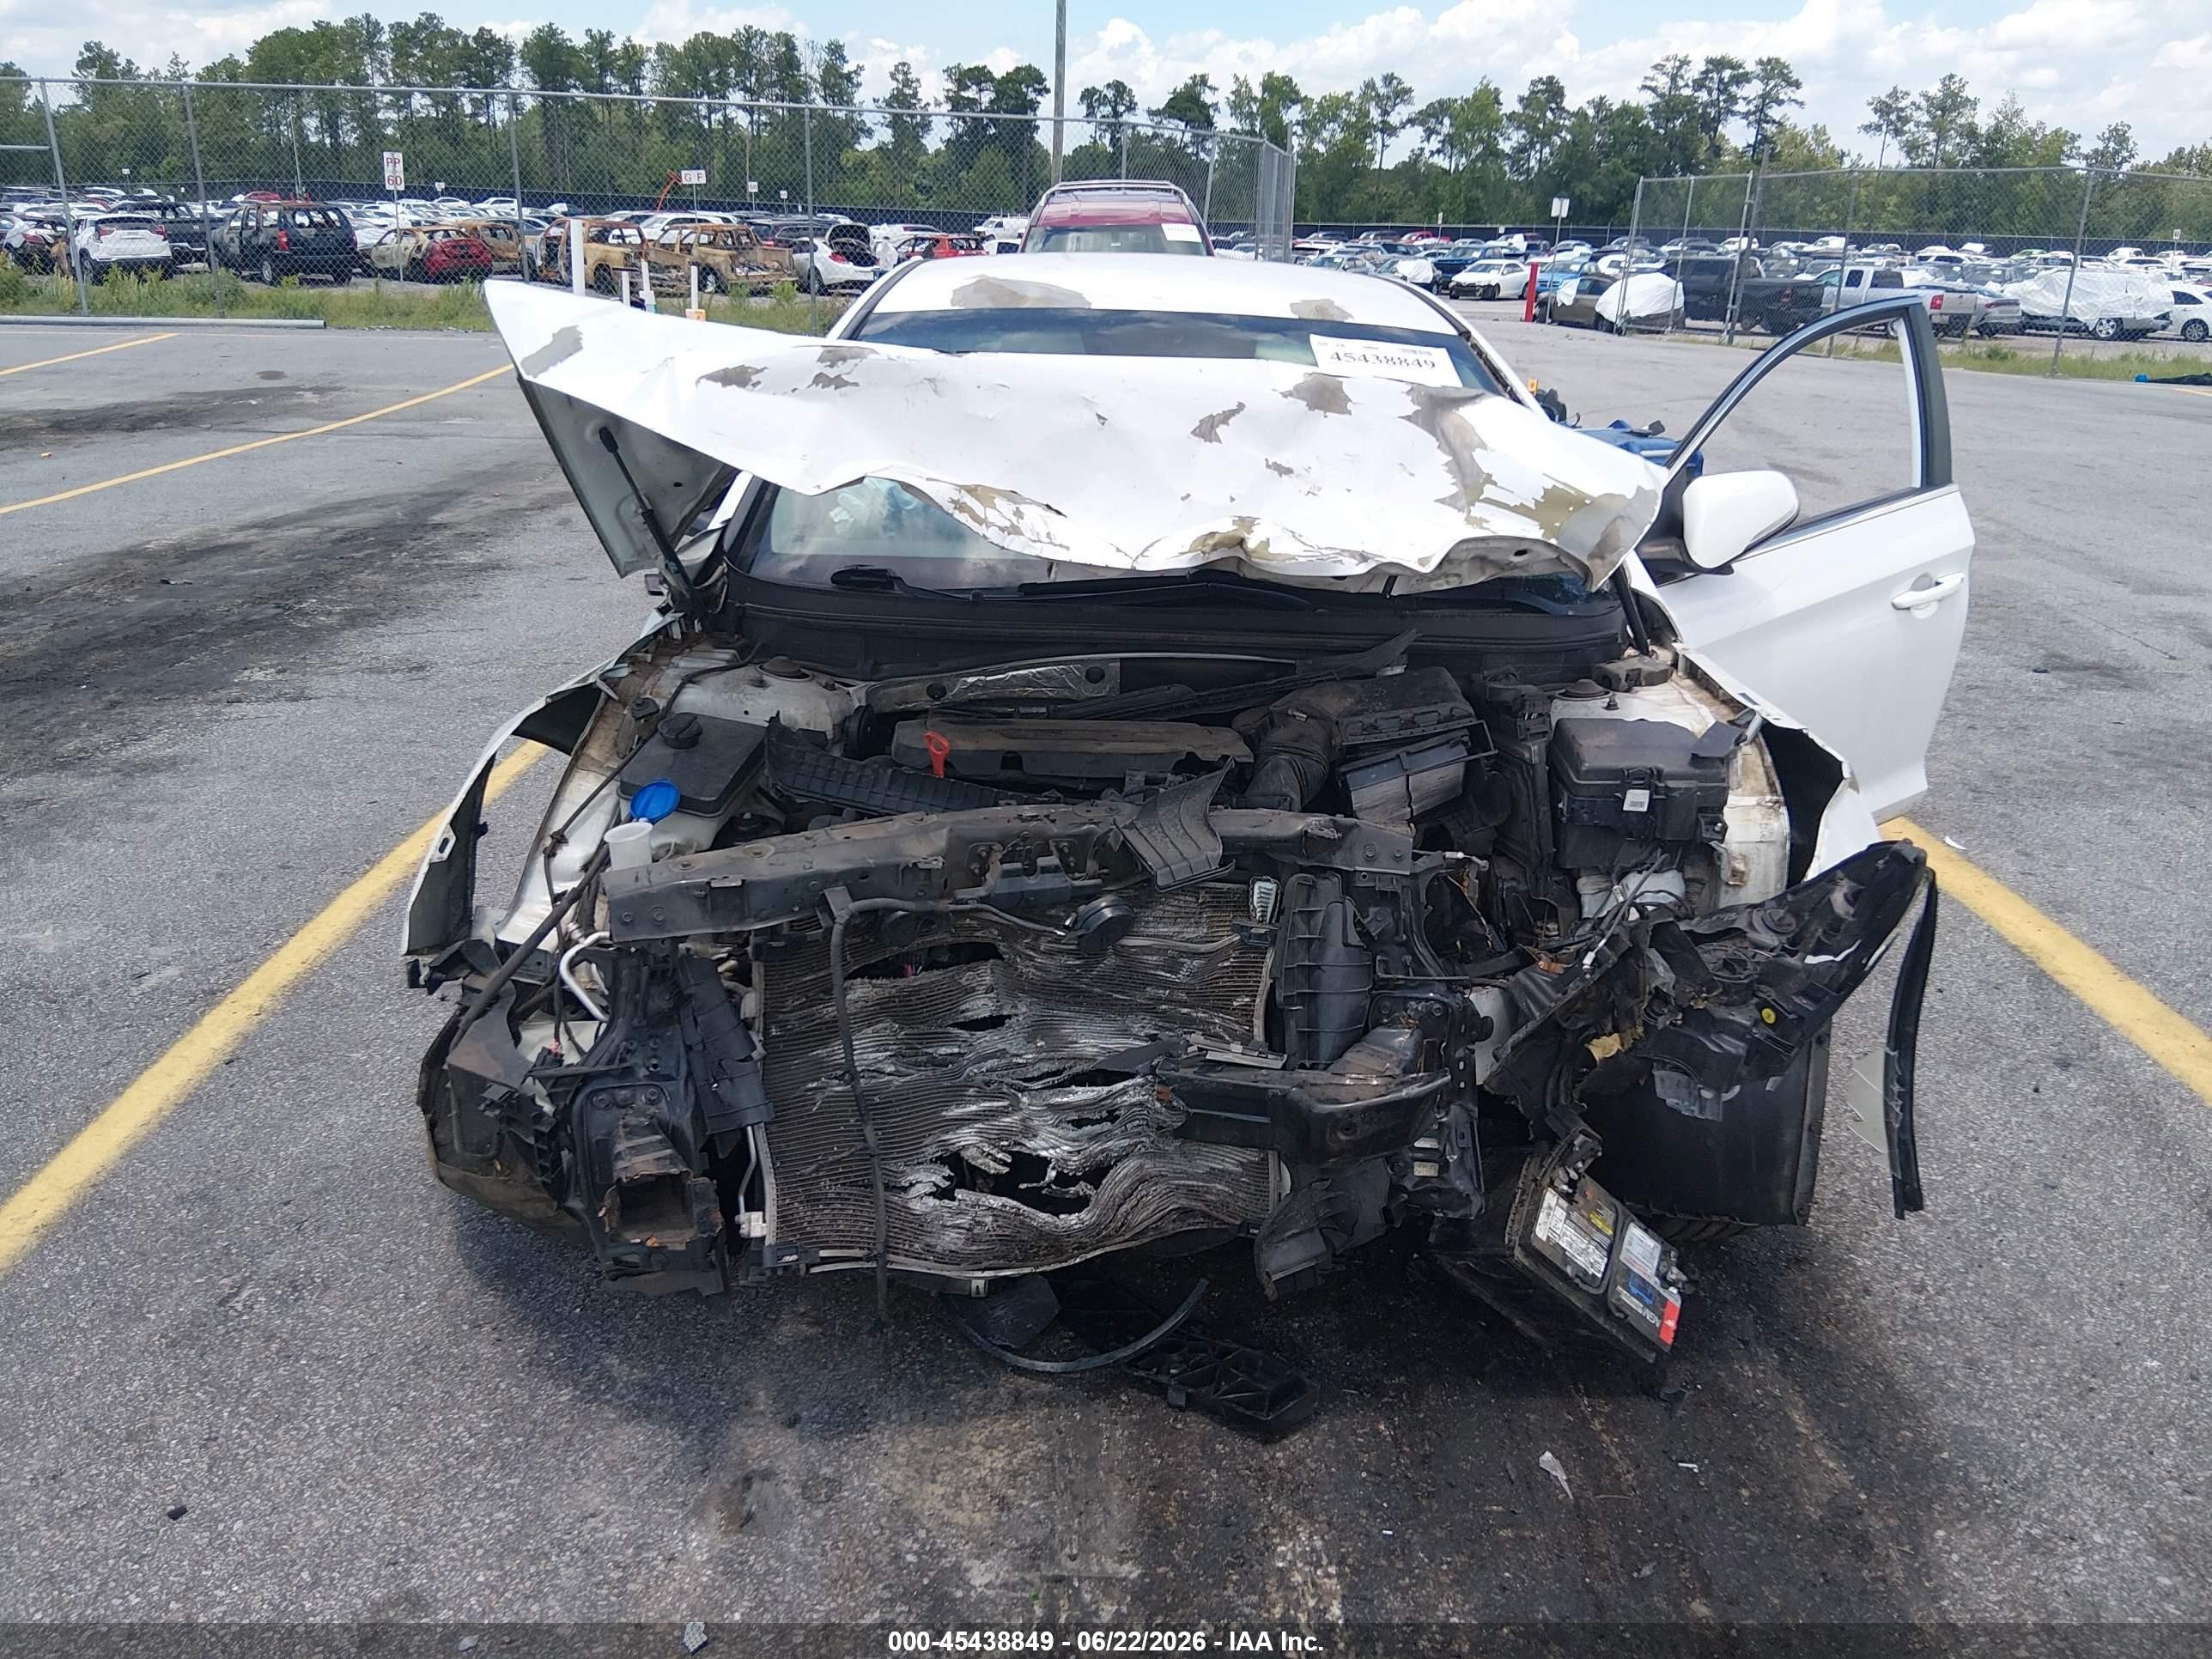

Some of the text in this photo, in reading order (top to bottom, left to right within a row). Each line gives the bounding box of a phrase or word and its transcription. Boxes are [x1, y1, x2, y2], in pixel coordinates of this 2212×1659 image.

[386, 157, 401, 167] PP
[387, 174, 403, 186] 60
[684, 173, 703, 183] G F
[1330, 350, 1437, 369] 45438849
